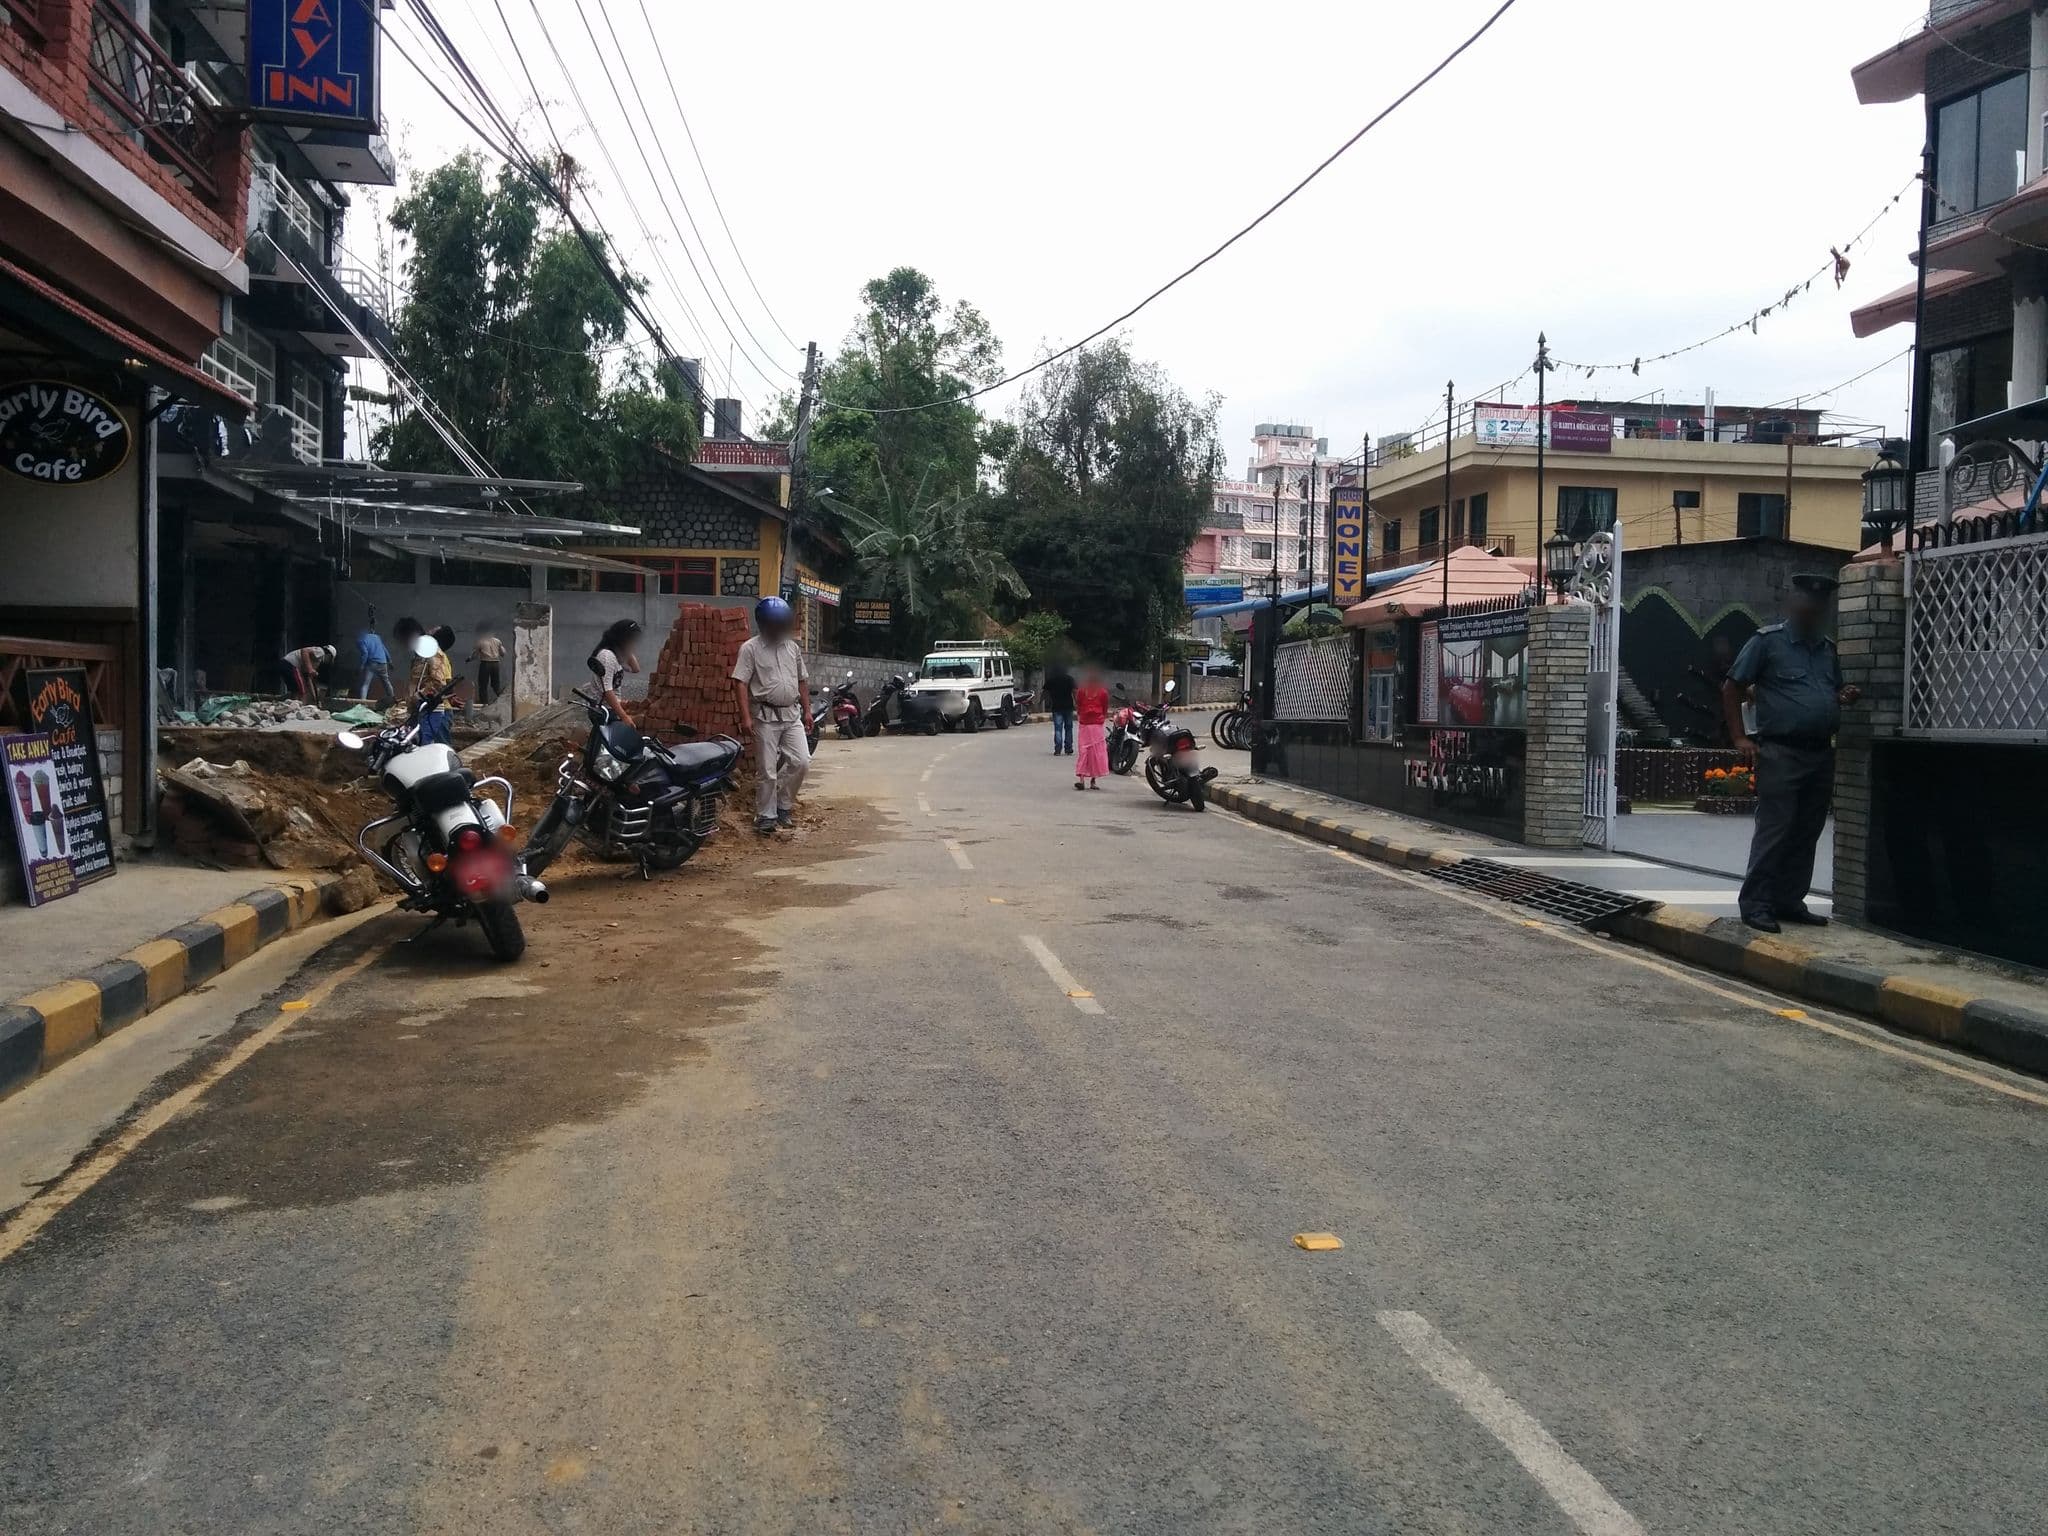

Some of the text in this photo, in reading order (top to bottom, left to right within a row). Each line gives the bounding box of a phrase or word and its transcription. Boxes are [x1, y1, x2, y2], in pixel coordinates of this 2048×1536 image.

[270, 71, 352, 107] INN
[0, 384, 122, 438] arly Bird
[1512, 410, 1548, 421] LAUNDY
[1500, 419, 1509, 432] 2
[1337, 504, 1361, 592] MONEY
[798, 583, 818, 596] GUEST
[818, 589, 840, 602] HOUSE
[58, 679, 80, 713] Bird
[7, 740, 49, 761] TAKE AWAY
